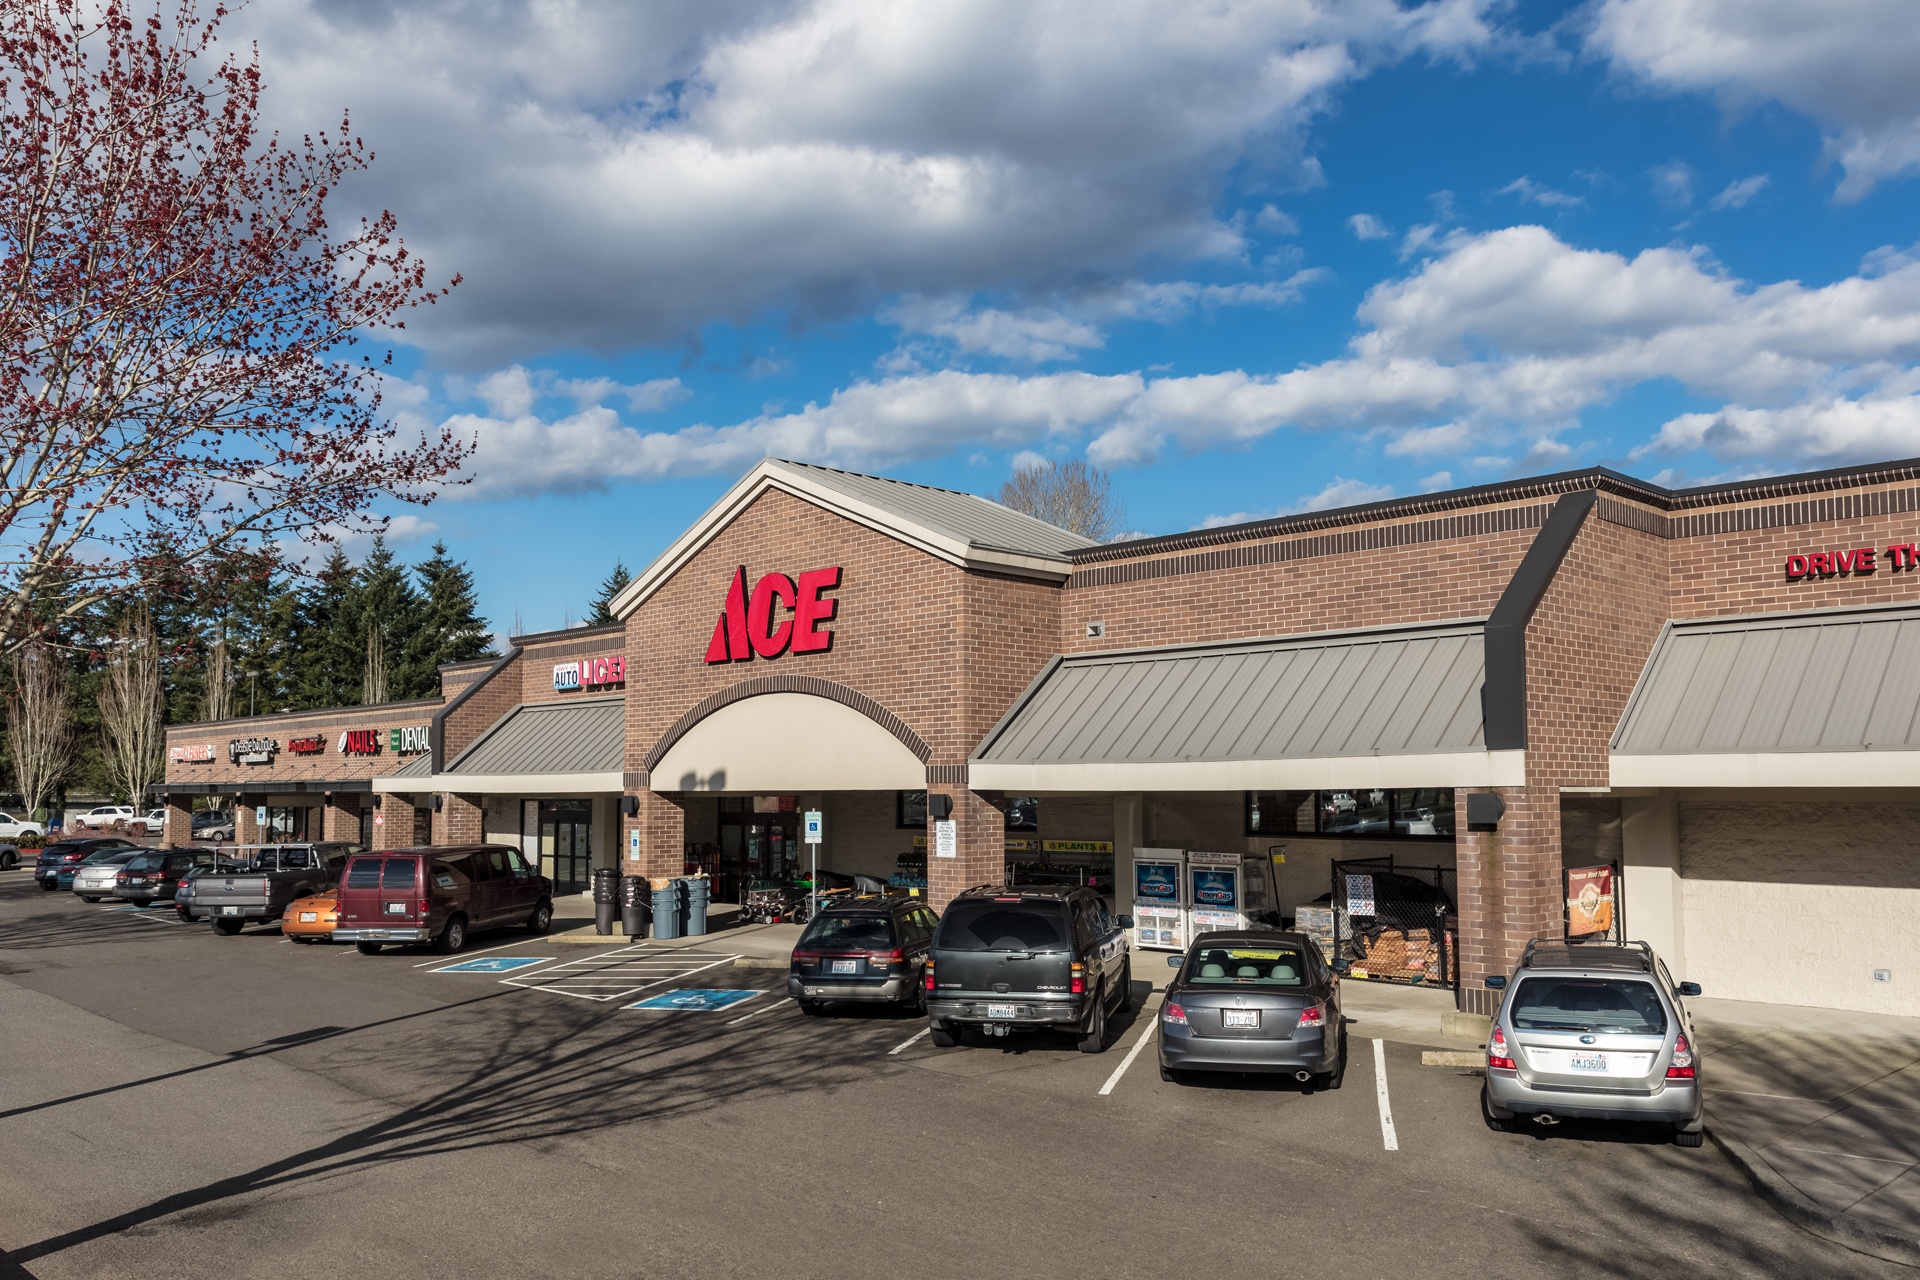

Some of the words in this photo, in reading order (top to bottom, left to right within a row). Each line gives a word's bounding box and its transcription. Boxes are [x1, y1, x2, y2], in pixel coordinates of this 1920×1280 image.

[1787, 548, 1877, 577] DRIVE
[704, 565, 843, 663] ACE
[555, 670, 577, 686] AUTO
[347, 730, 374, 752] NAILS
[402, 727, 430, 751] DENTAL
[1198, 891, 1231, 899] AmeriGas
[1571, 1059, 1606, 1069] AMJ3600
